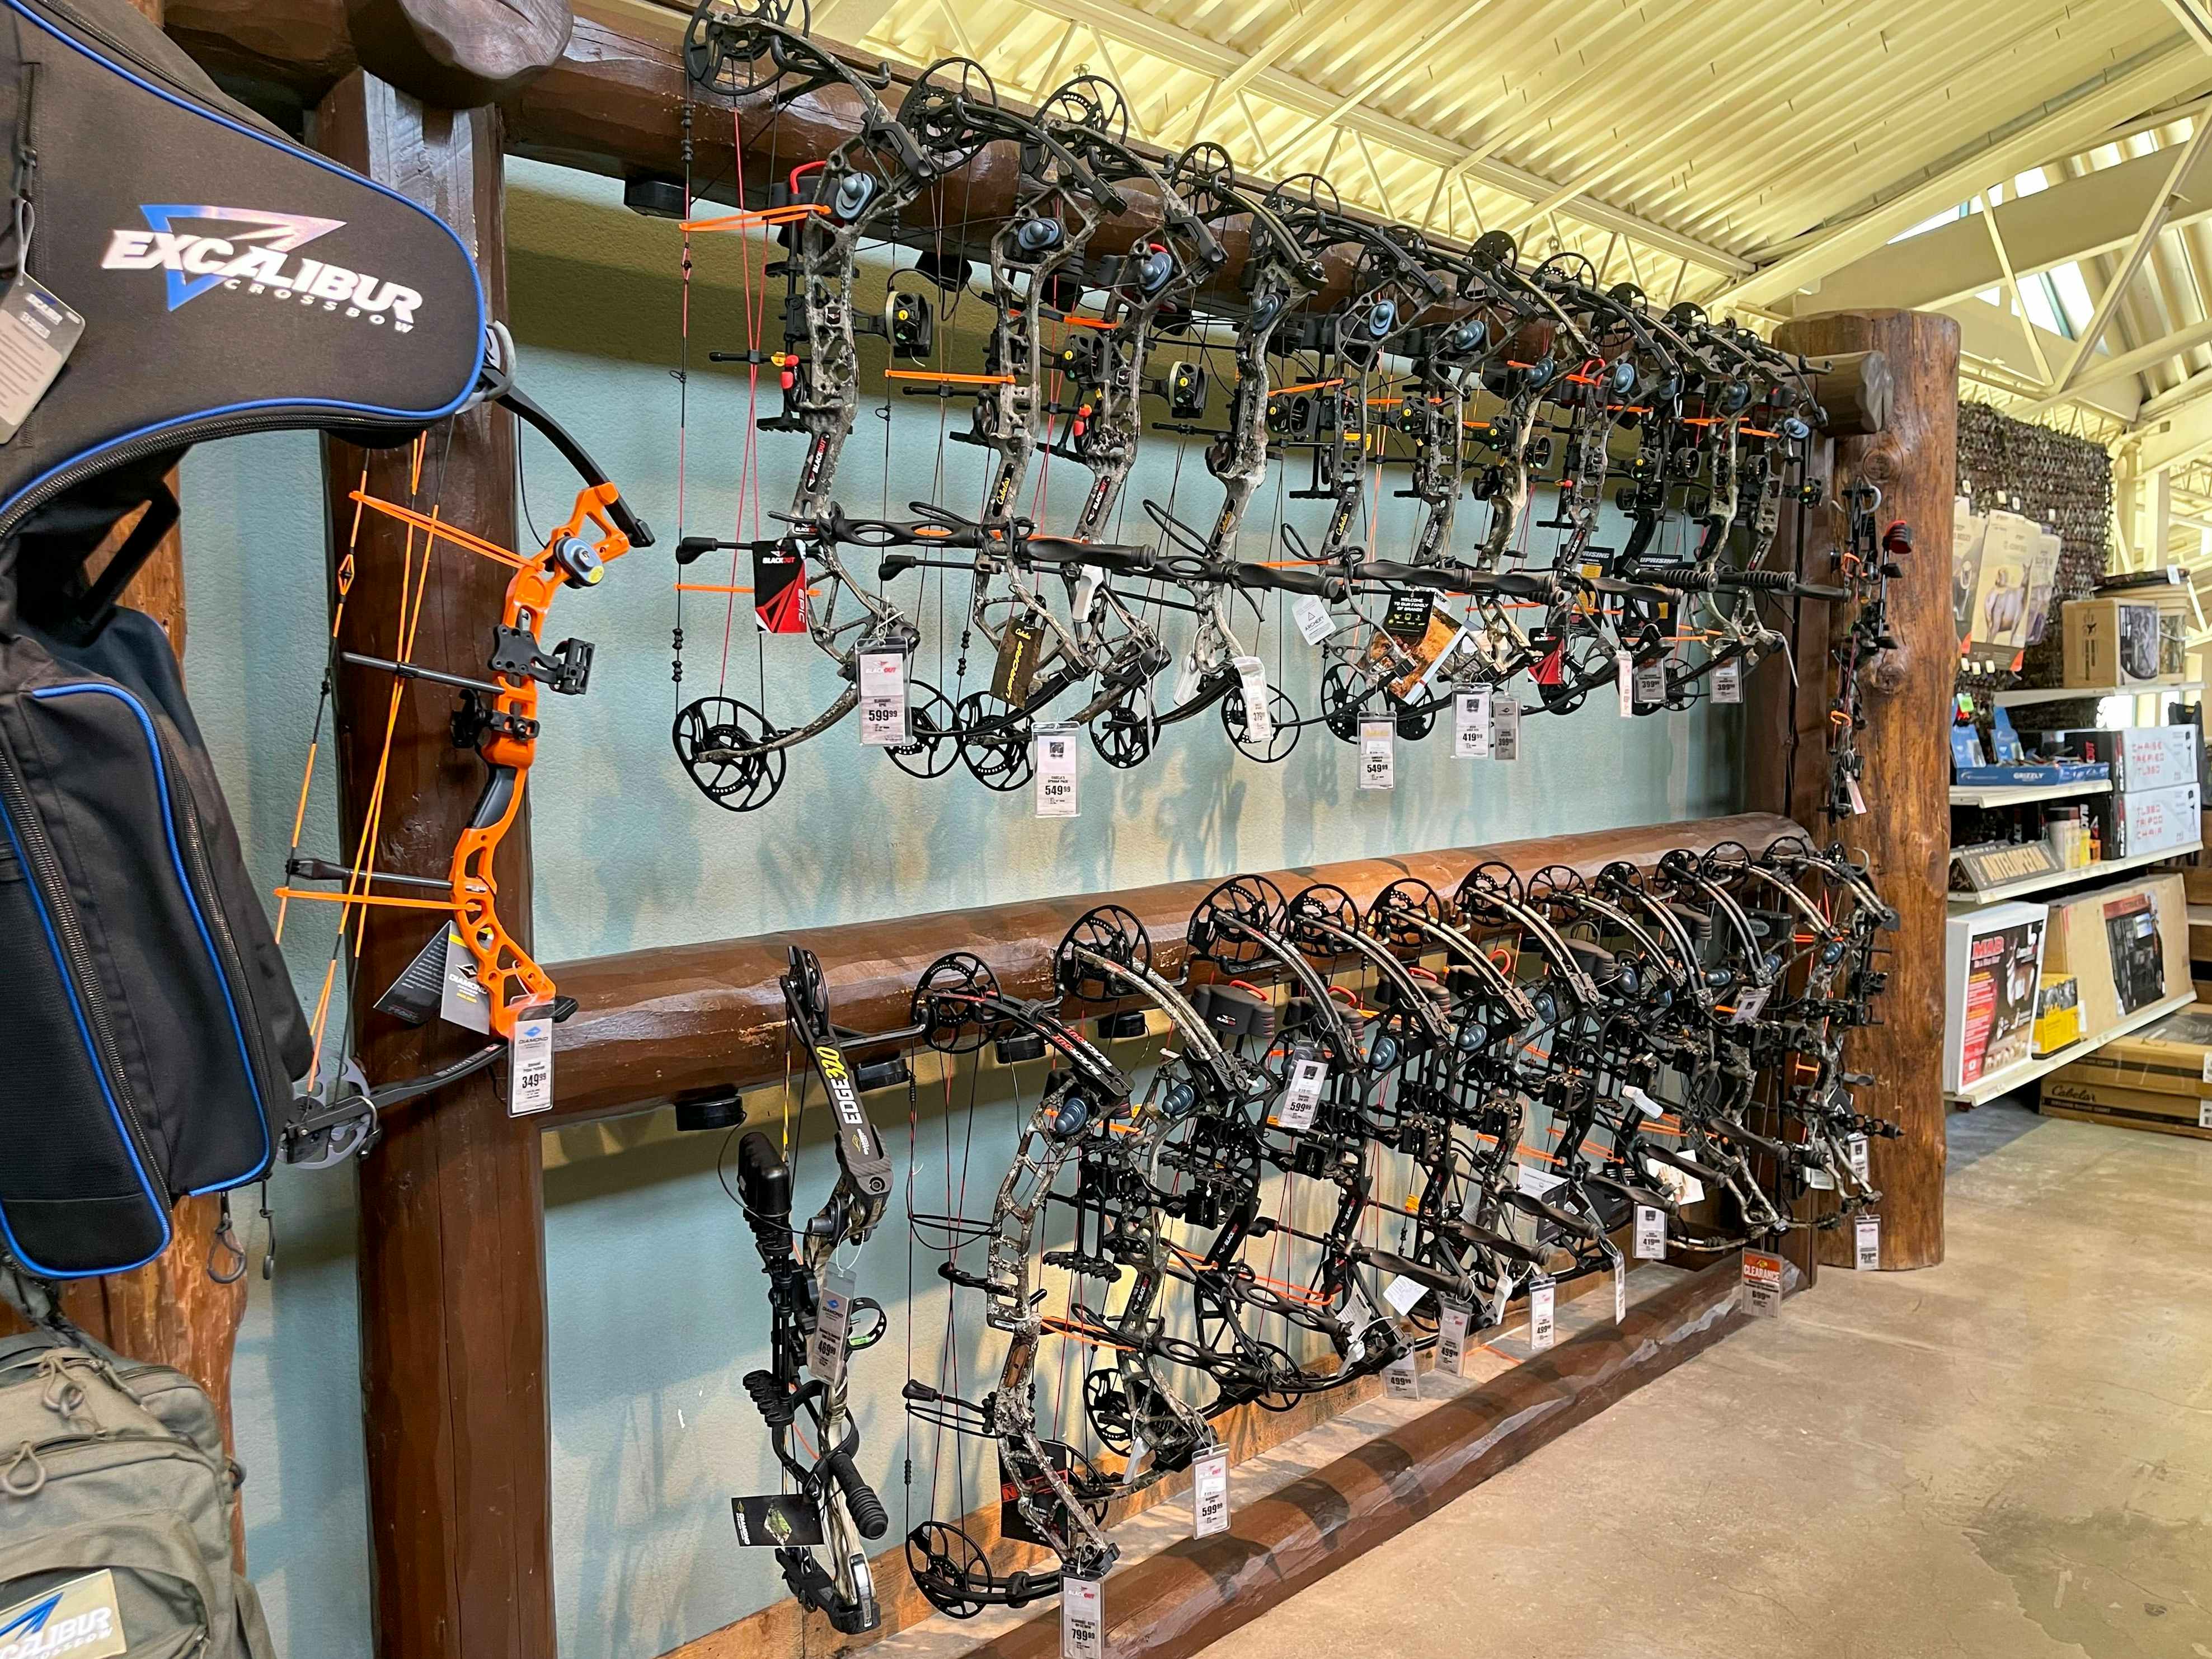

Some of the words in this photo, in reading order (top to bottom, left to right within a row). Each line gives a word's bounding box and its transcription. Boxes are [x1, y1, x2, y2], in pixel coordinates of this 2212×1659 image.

[100, 228, 424, 325] EXCALIBUR
[223, 278, 414, 333] CROSSBOW
[812, 438, 827, 474] BLACKOUT
[1093, 481, 1107, 511] BLACKOUT
[448, 973, 489, 994] DIAMOND
[1052, 1035, 1102, 1075] BLACKOUT
[830, 1079, 863, 1124] EDGE
[1744, 1265, 1780, 1282] CLEARANCE
